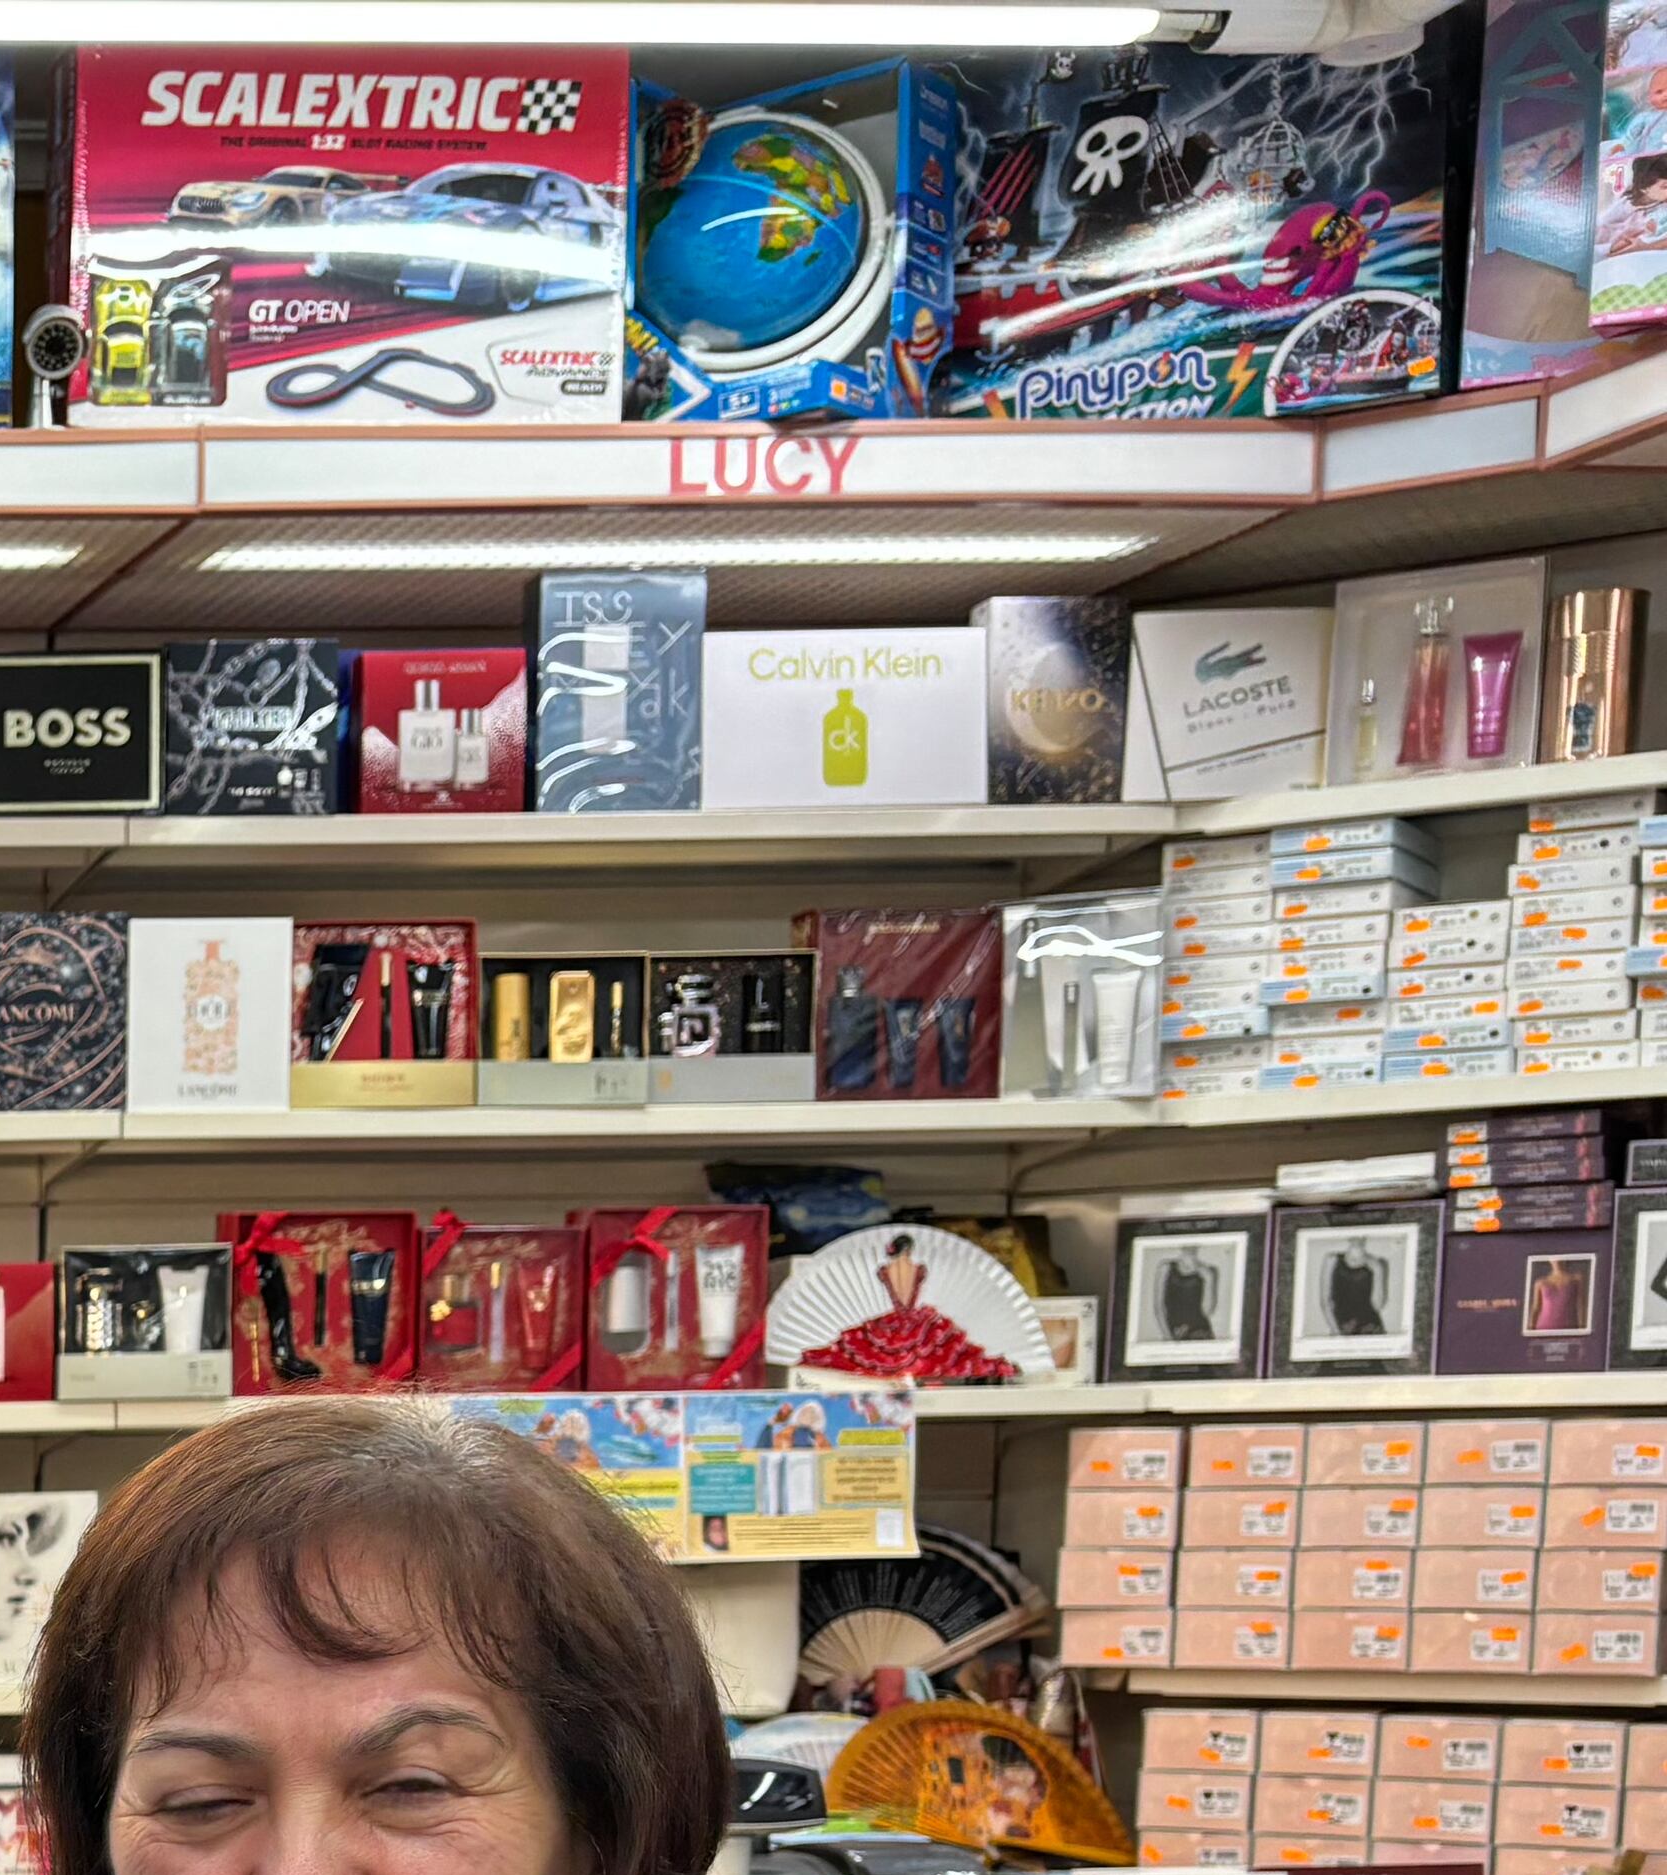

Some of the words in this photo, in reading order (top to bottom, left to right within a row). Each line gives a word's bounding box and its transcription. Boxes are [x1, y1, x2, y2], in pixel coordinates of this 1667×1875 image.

[141, 71, 522, 130] SCALEXTRIC
[249, 299, 283, 322] GT
[286, 299, 350, 323] OPEN
[1017, 346, 1216, 420] Pinypon
[670, 438, 861, 497] LUCY
[749, 648, 854, 682] Calvin
[862, 648, 942, 681] Klein
[1183, 676, 1293, 718] LACOSTE
[4, 707, 131, 748] BOSS
[827, 717, 860, 752] ck
